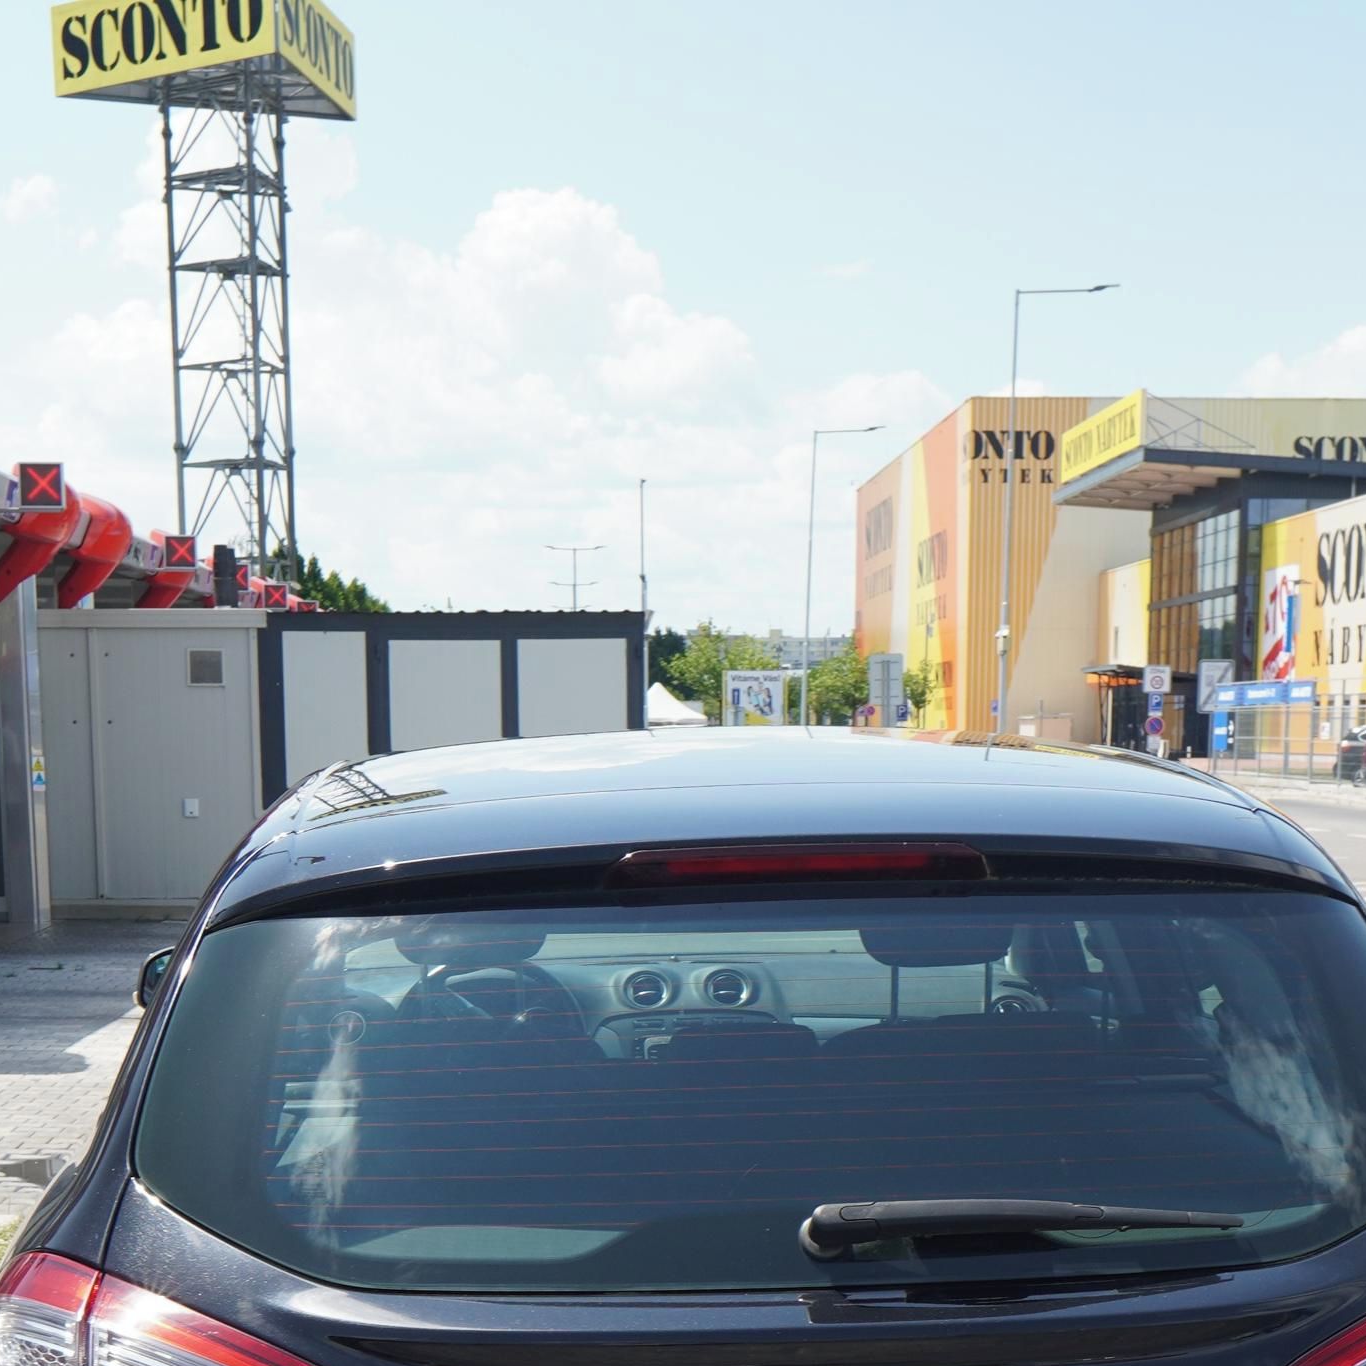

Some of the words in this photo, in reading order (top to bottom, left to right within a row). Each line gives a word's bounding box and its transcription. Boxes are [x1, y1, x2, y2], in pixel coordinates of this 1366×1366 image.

[61, 0, 263, 80] SCONTO
[283, 0, 354, 100] SCONTO
[964, 430, 1055, 461] ONTO
